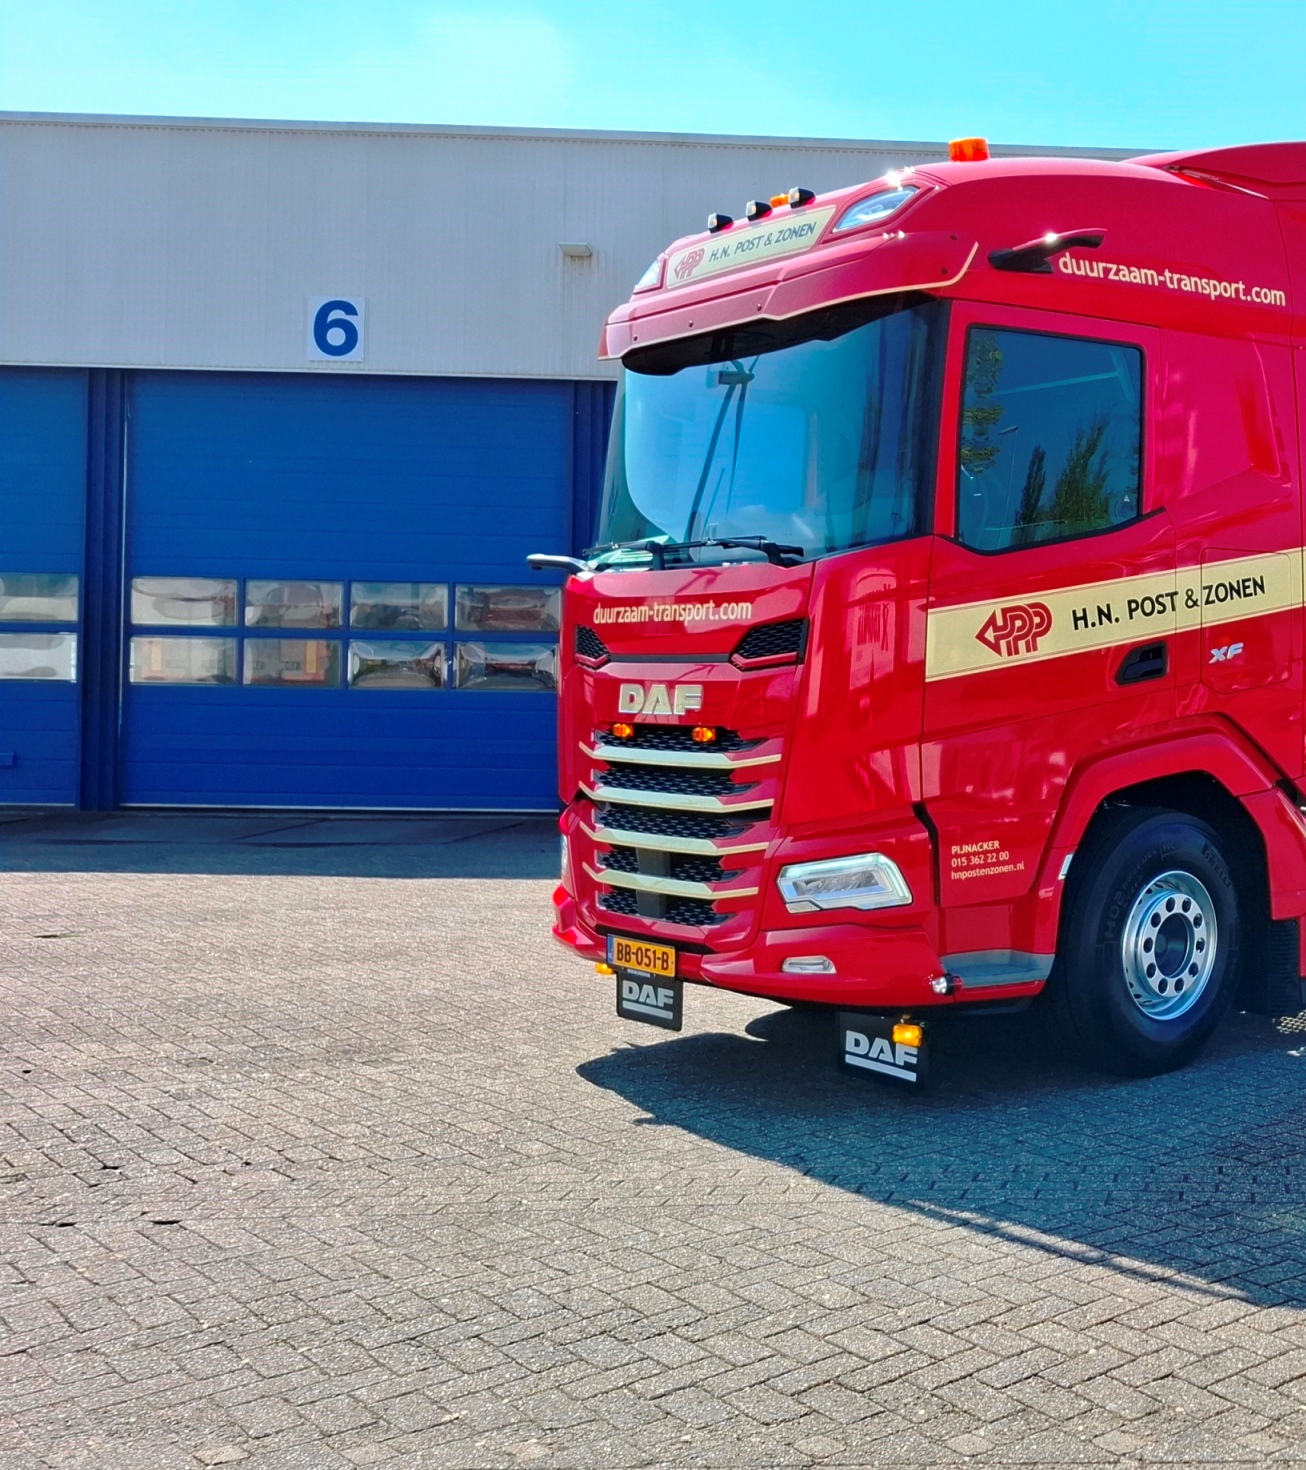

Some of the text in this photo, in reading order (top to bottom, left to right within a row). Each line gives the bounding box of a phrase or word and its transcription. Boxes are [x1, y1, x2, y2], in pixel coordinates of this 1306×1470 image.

[709, 245, 730, 262] H.N.
[734, 235, 765, 255] POST
[764, 233, 773, 247] &
[774, 222, 817, 243] ZONEN
[1058, 252, 1286, 306] duurzaam-transport.com
[313, 299, 359, 357] 6
[593, 600, 752, 626] duurzaam-transport.com
[1071, 604, 1120, 631] H.N.
[1128, 591, 1178, 620] POST
[1184, 587, 1199, 608] &
[1202, 575, 1266, 605] ZONEN
[1208, 642, 1244, 664] XF
[618, 683, 704, 715] DAF
[951, 840, 1000, 855] PIJNACKER
[951, 851, 1010, 867] 015 362 22 00
[951, 860, 1024, 880] hnpostenzonen.nl
[616, 942, 669, 971] BB-051-B
[622, 980, 674, 1007] DAF
[845, 1030, 918, 1066] DAF
